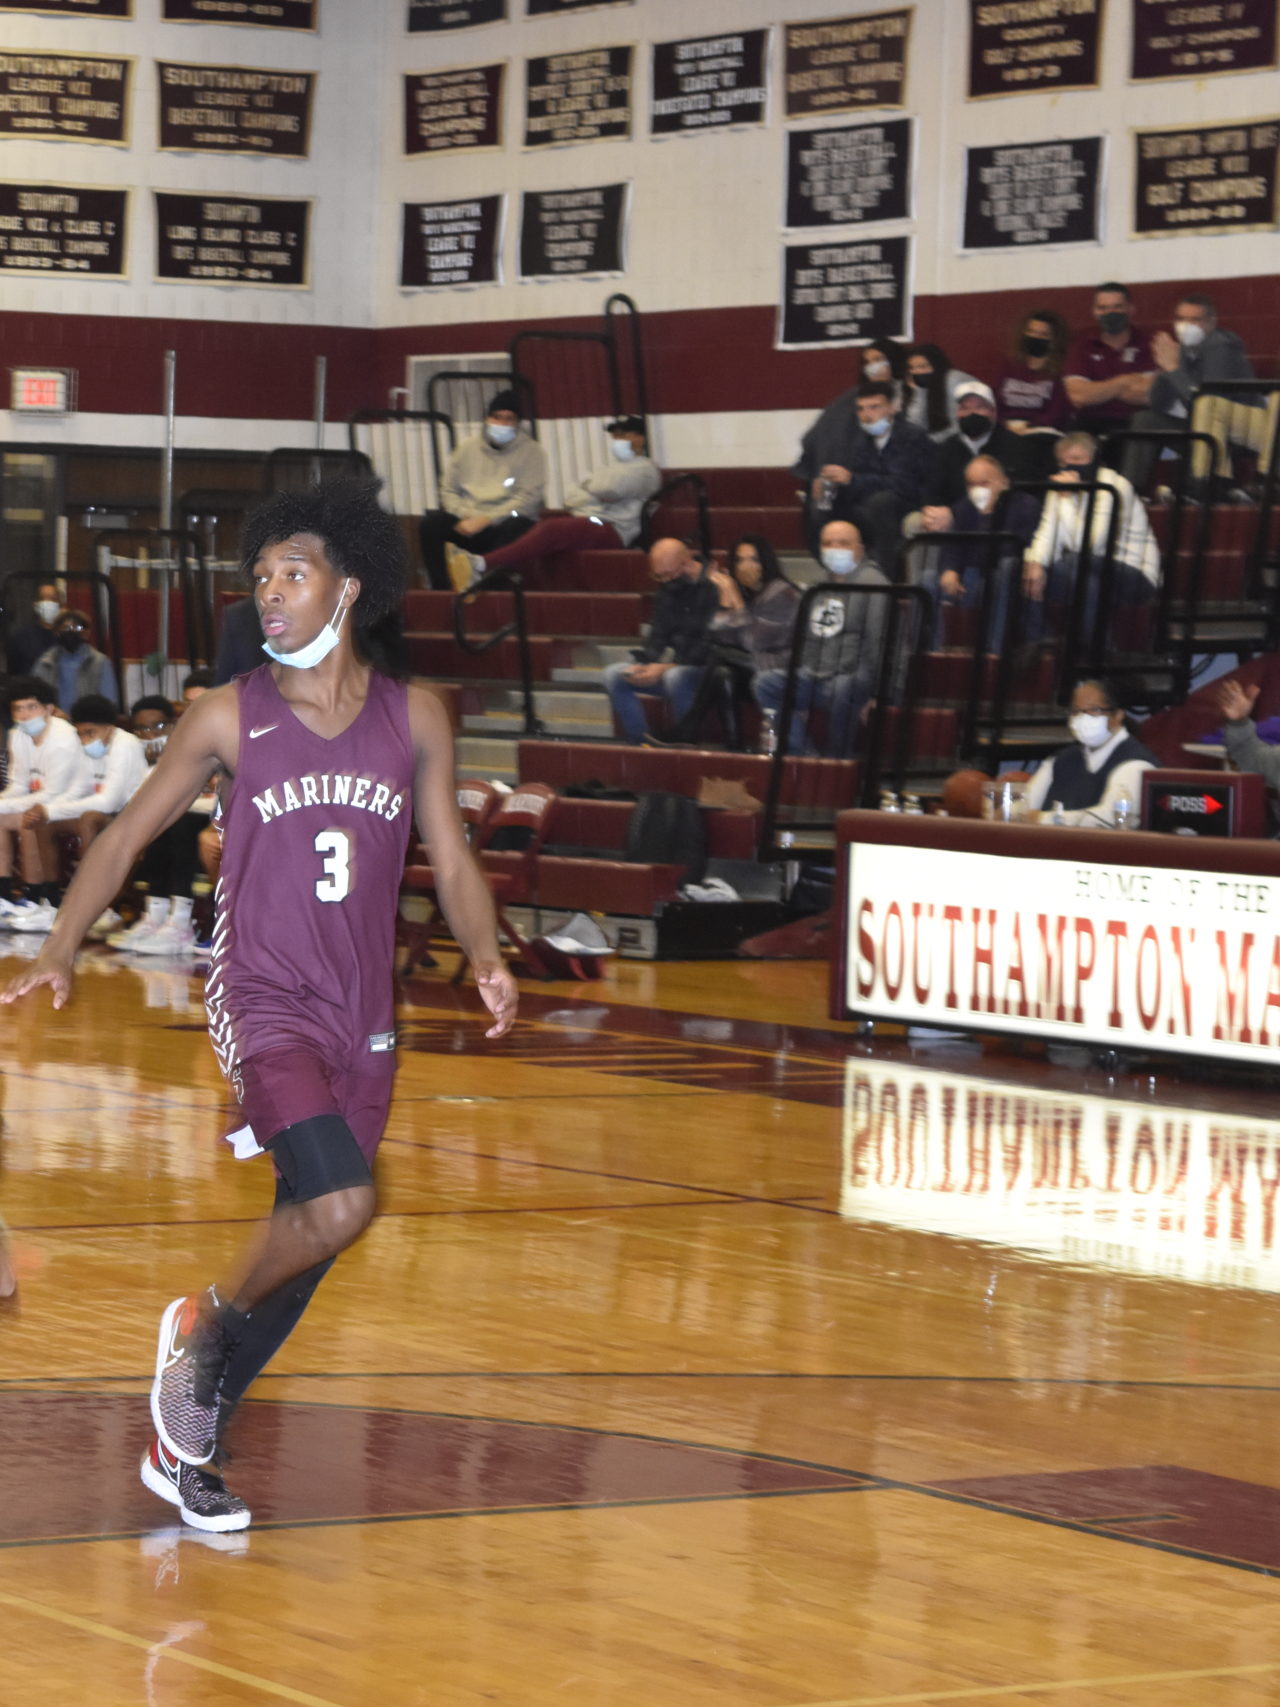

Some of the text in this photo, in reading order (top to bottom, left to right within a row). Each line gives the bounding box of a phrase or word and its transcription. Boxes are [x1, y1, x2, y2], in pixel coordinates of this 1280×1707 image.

[163, 68, 306, 94] SOUTHAMPTON
[251, 774, 403, 825] MARINERS
[314, 831, 350, 903] 3
[1076, 870, 1153, 904] HOME
[1217, 882, 1270, 914] THE
[857, 897, 1196, 1039] SOUTHAMPTON
